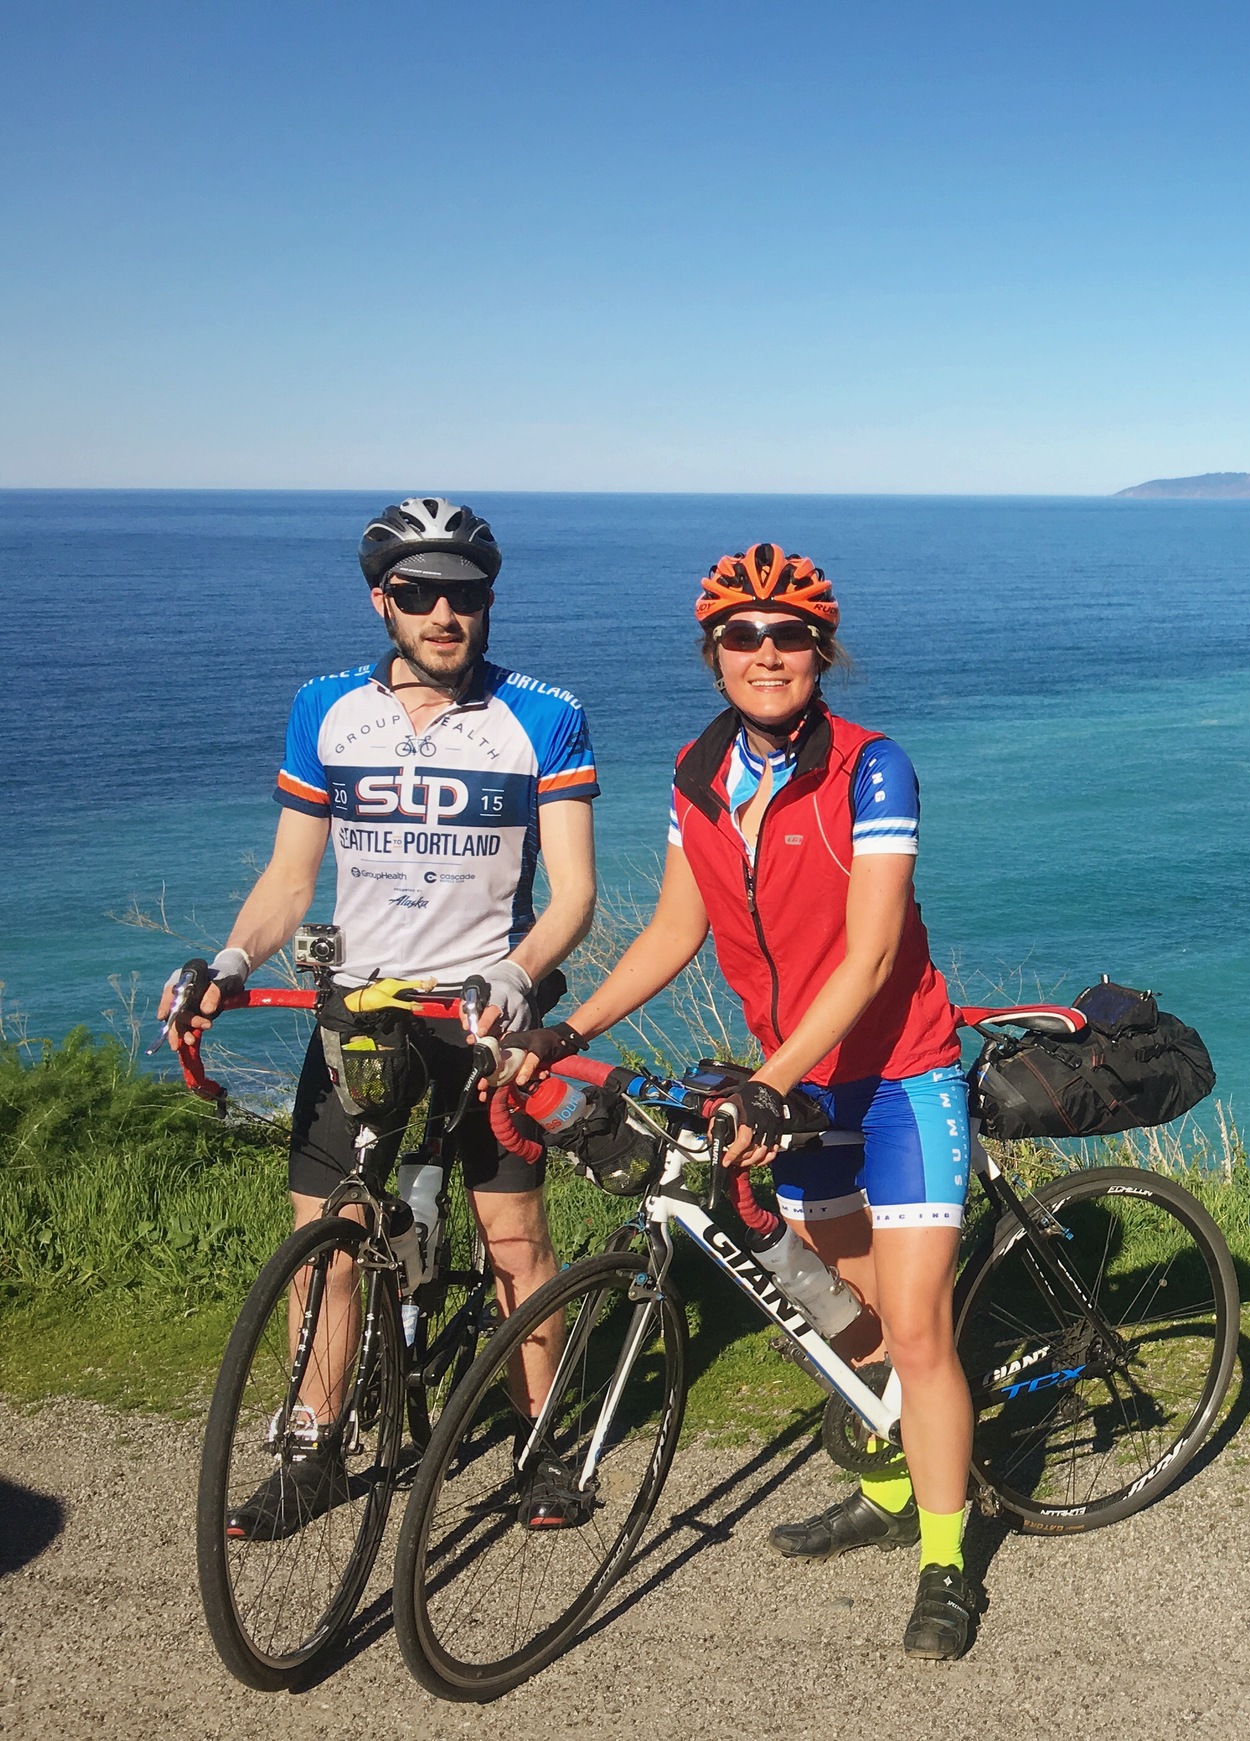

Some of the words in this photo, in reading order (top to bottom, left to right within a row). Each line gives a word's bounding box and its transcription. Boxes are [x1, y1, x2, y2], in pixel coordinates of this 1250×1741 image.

[335, 714, 401, 754] GROUP
[440, 716, 500, 760] EALTH
[334, 788, 348, 805] 20
[355, 765, 469, 825] stp
[480, 796, 503, 811] 15
[339, 827, 393, 853] SEATTLE
[403, 831, 501, 857] PORTLAND
[388, 894, 430, 908] Alaska
[932, 1071, 963, 1186] SUMMT
[701, 1223, 815, 1338] GIANT
[982, 1345, 1051, 1388] GIANT
[1000, 1363, 1088, 1400] TCX
[1023, 1519, 1065, 1533] GATORS
